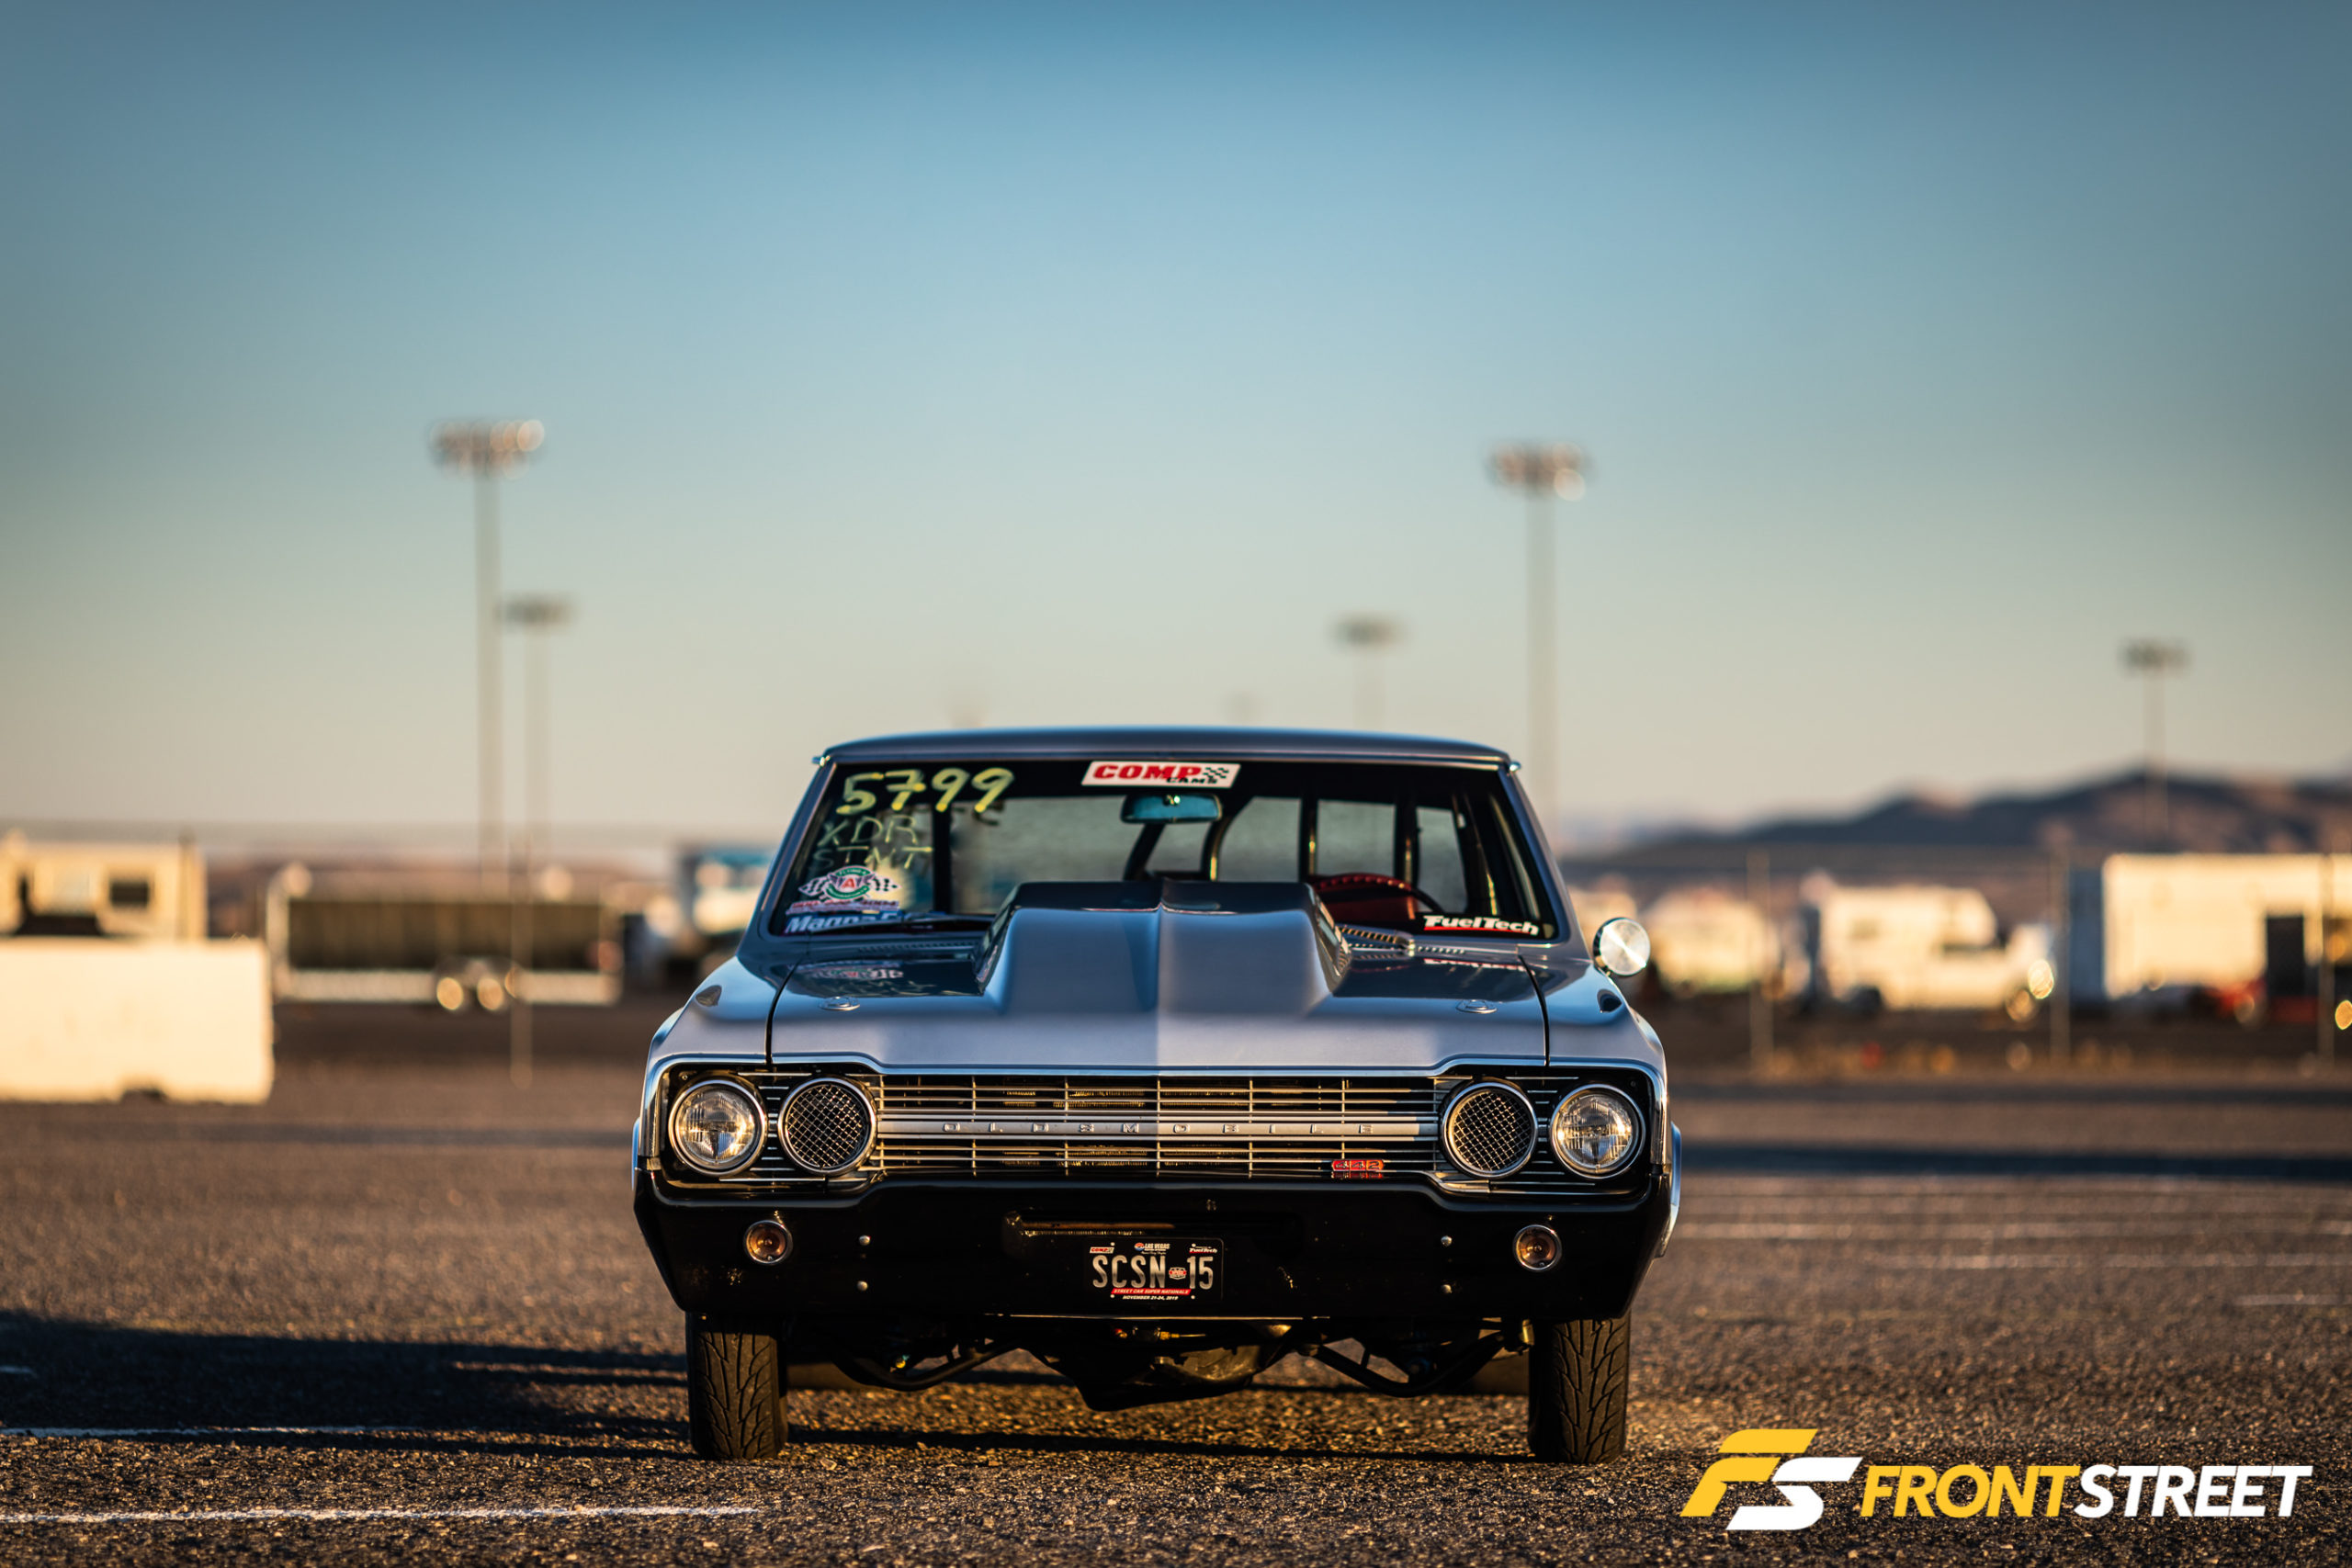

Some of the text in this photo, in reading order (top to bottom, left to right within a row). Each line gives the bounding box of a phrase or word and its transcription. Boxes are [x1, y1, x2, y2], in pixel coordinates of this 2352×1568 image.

[1092, 764, 1202, 780] COMP
[836, 768, 1013, 815] 5799
[1423, 915, 1540, 936] FuelTech
[943, 1122, 1374, 1134] OLDSMOBILE
[1335, 1160, 1380, 1170] 442
[1092, 1255, 1214, 1290] SCSN 15
